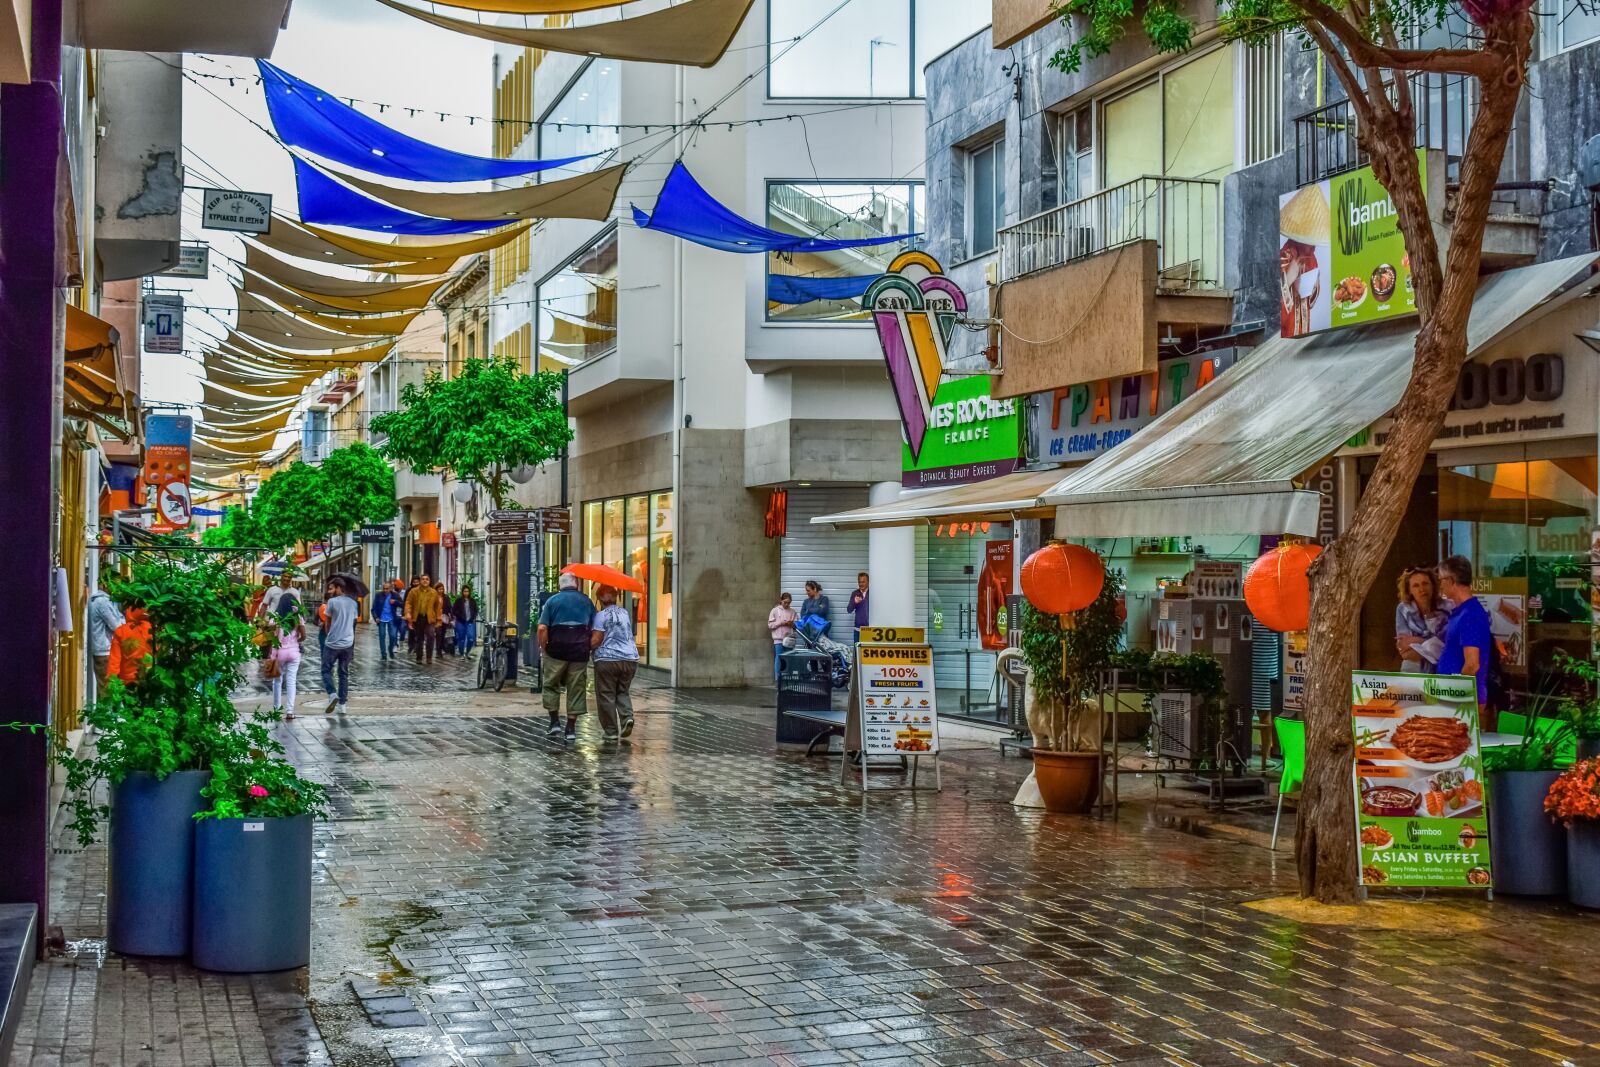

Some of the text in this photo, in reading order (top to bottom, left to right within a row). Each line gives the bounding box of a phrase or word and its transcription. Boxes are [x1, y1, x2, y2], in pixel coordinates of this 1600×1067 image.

[223, 193, 268, 216] ΟΔΟΝΤΙΑΤΡΟΣ
[1350, 193, 1397, 226] bamb
[209, 214, 237, 222] ΚΥΡΙΑΚΟΣ
[926, 299, 953, 311] ICE
[957, 395, 1016, 424] ROCHER
[945, 427, 989, 444] FRANCE
[1050, 438, 1064, 456] ICE
[920, 465, 996, 482] BOTANICAL BEAUTY EXPERTS
[1320, 465, 1334, 546] amboo
[361, 528, 389, 536] Milano
[1537, 526, 1591, 553] bamb
[998, 545, 1010, 553] MATTE
[872, 628, 896, 642] 30
[863, 649, 927, 659] SMOOTHIES
[881, 667, 918, 678] 100%
[1361, 678, 1388, 689] Asian
[1289, 686, 1304, 694] JUIC
[1372, 689, 1423, 701] Restaurant
[1430, 687, 1466, 697] bamboo
[1412, 828, 1442, 836] bamboo
[1372, 852, 1480, 864] ASIAN BUFFET
